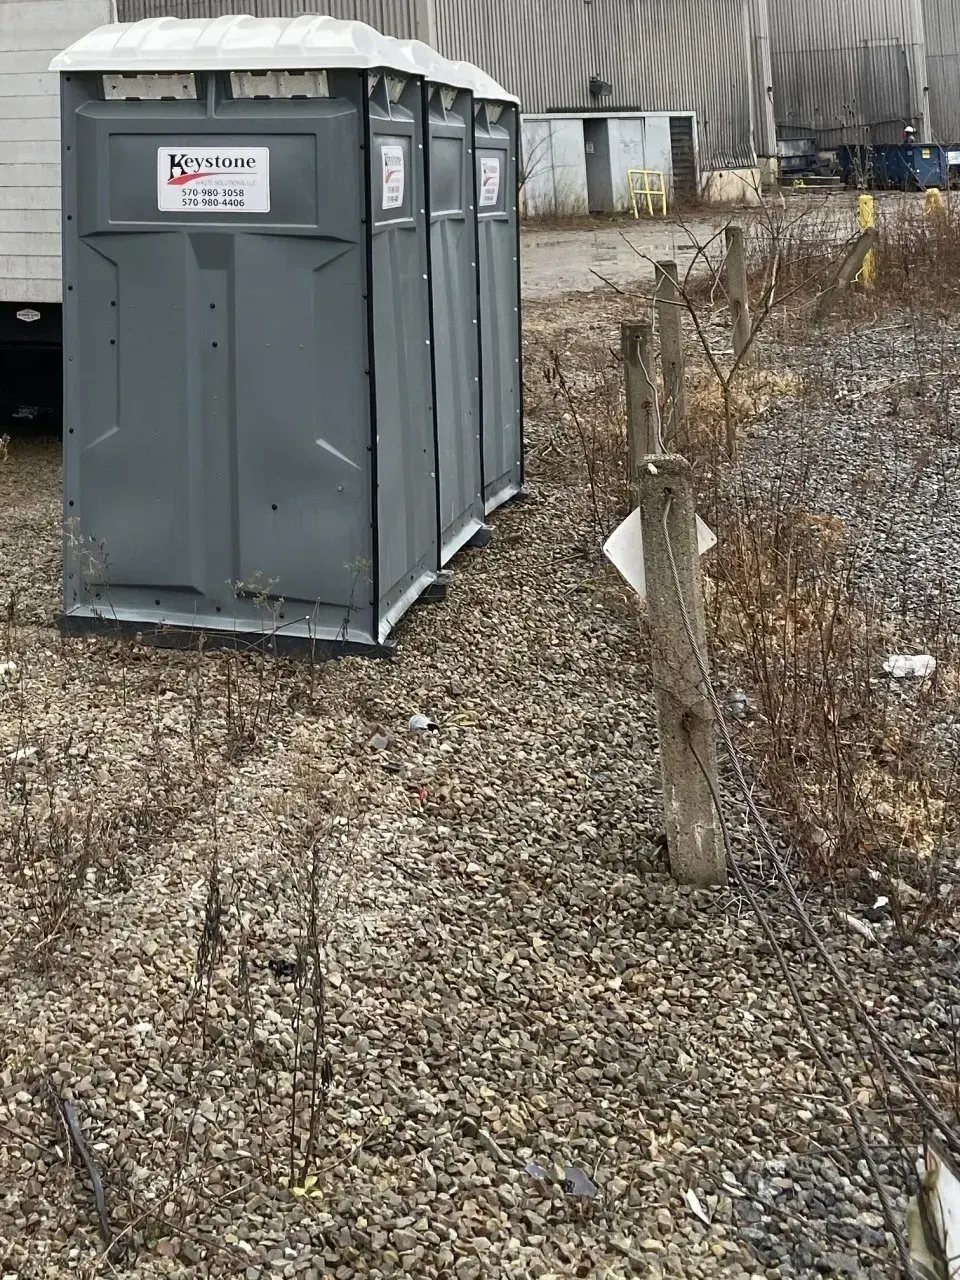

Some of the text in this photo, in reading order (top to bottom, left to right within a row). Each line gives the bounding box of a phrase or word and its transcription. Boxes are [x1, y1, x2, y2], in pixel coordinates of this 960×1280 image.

[167, 153, 257, 182] Keystone
[181, 188, 245, 197] 570-980-3058
[181, 198, 245, 207] 570-980-4406
